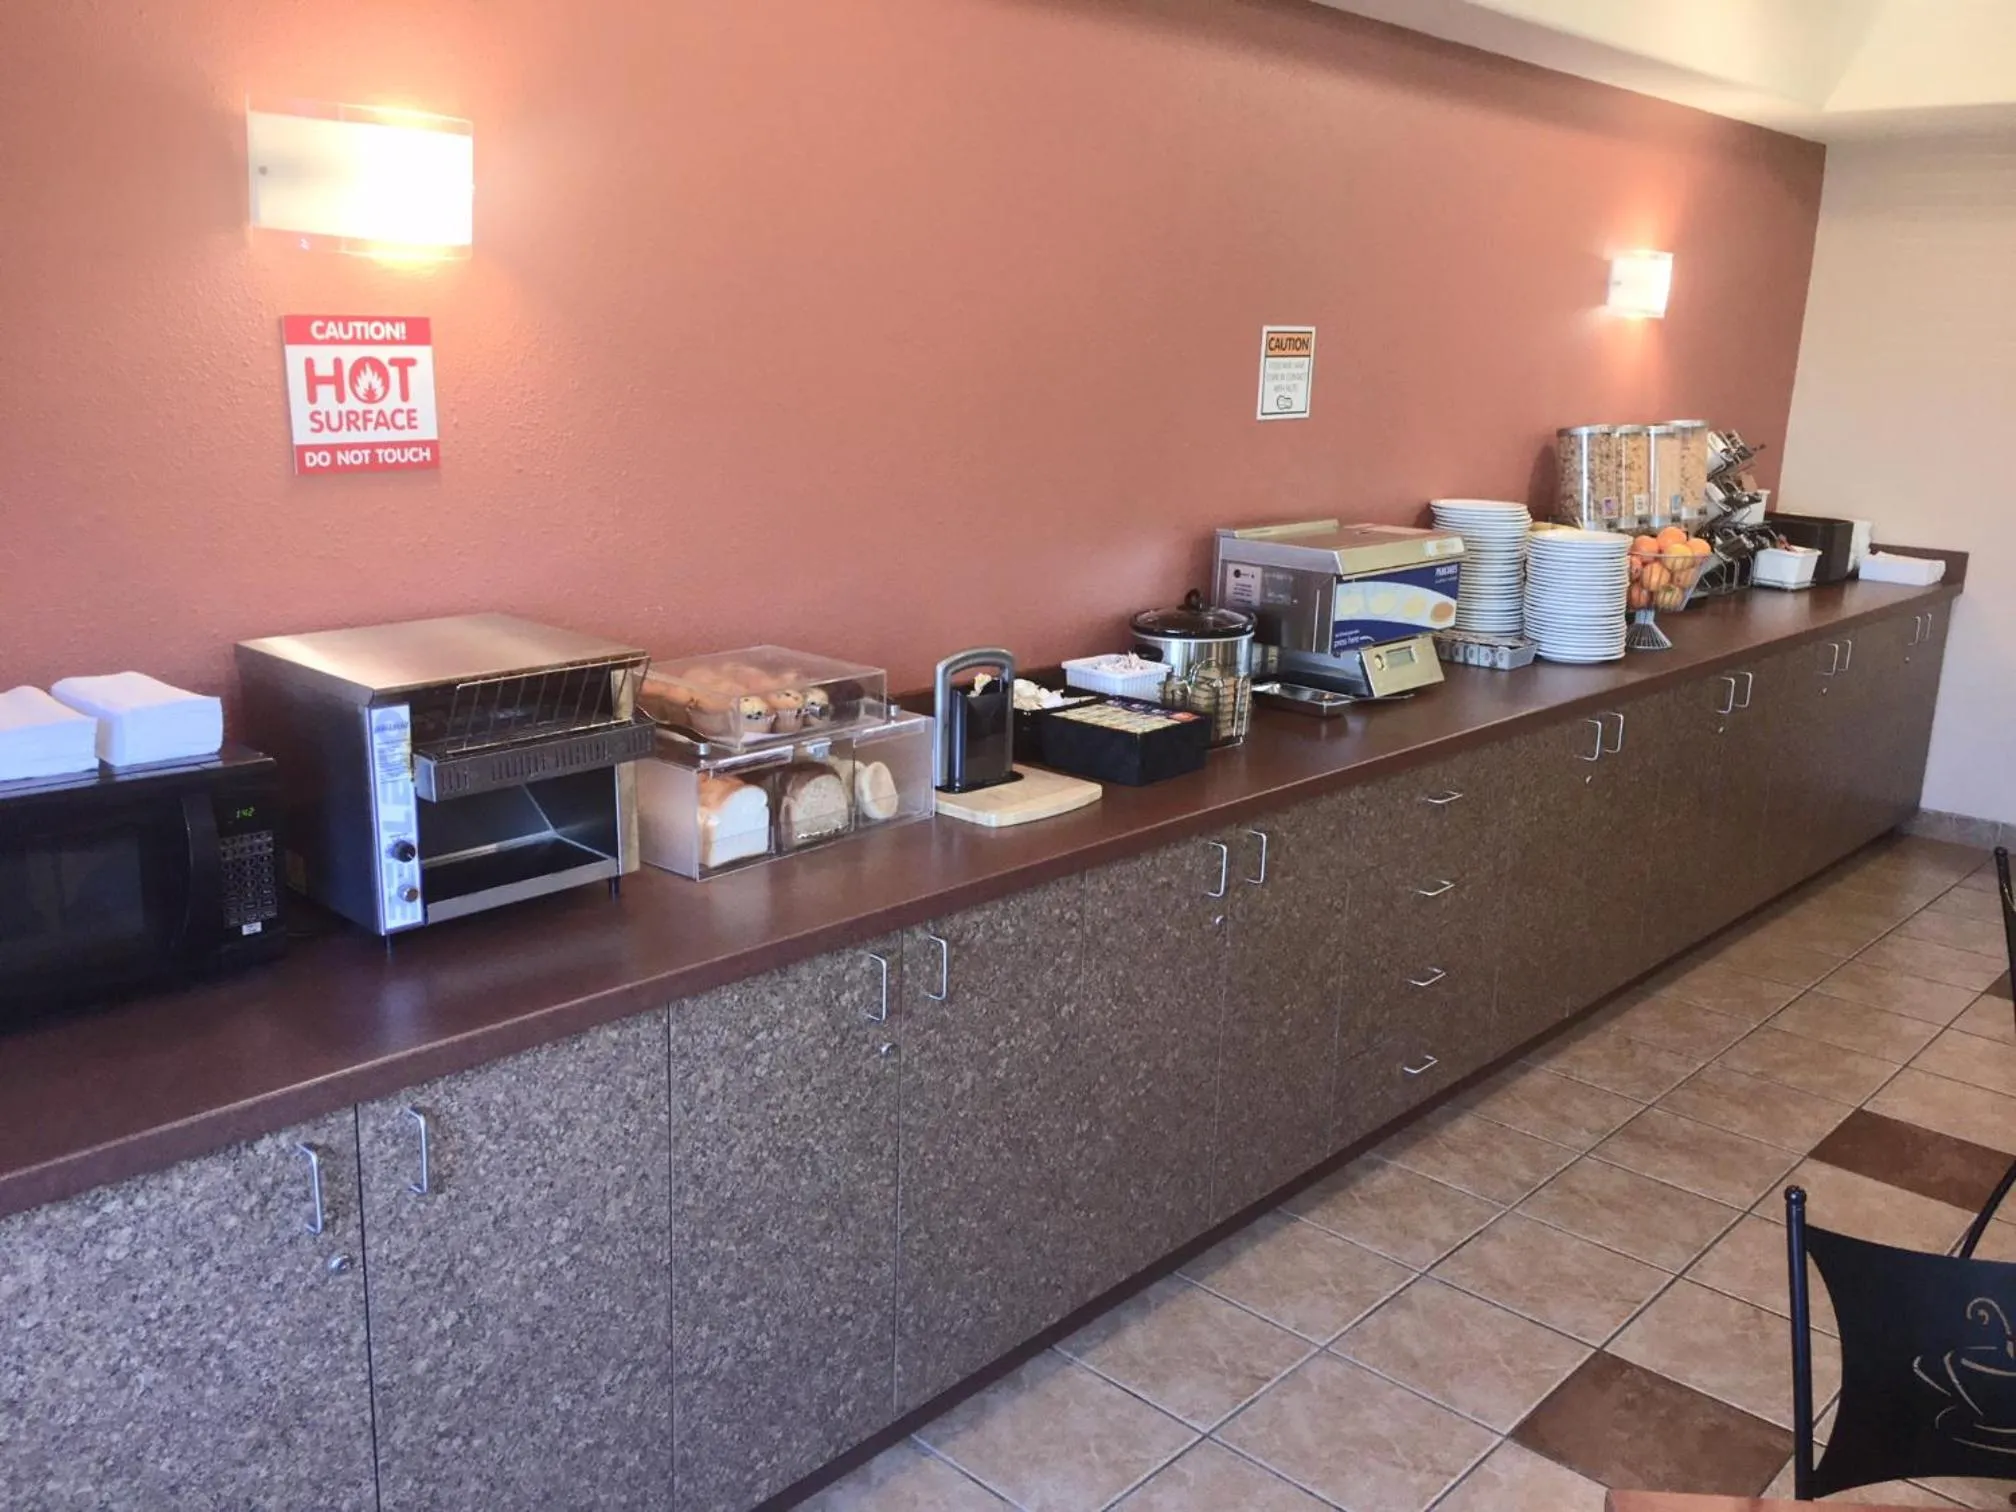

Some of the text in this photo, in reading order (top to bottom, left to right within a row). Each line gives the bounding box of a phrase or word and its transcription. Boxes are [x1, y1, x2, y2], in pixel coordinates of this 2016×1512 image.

[310, 320, 407, 340] CAUTION!
[1268, 336, 1310, 351] CAUTION
[304, 356, 417, 405] HOT
[309, 408, 419, 433] SURFACE
[304, 447, 431, 467] DO NOT TOUCH
